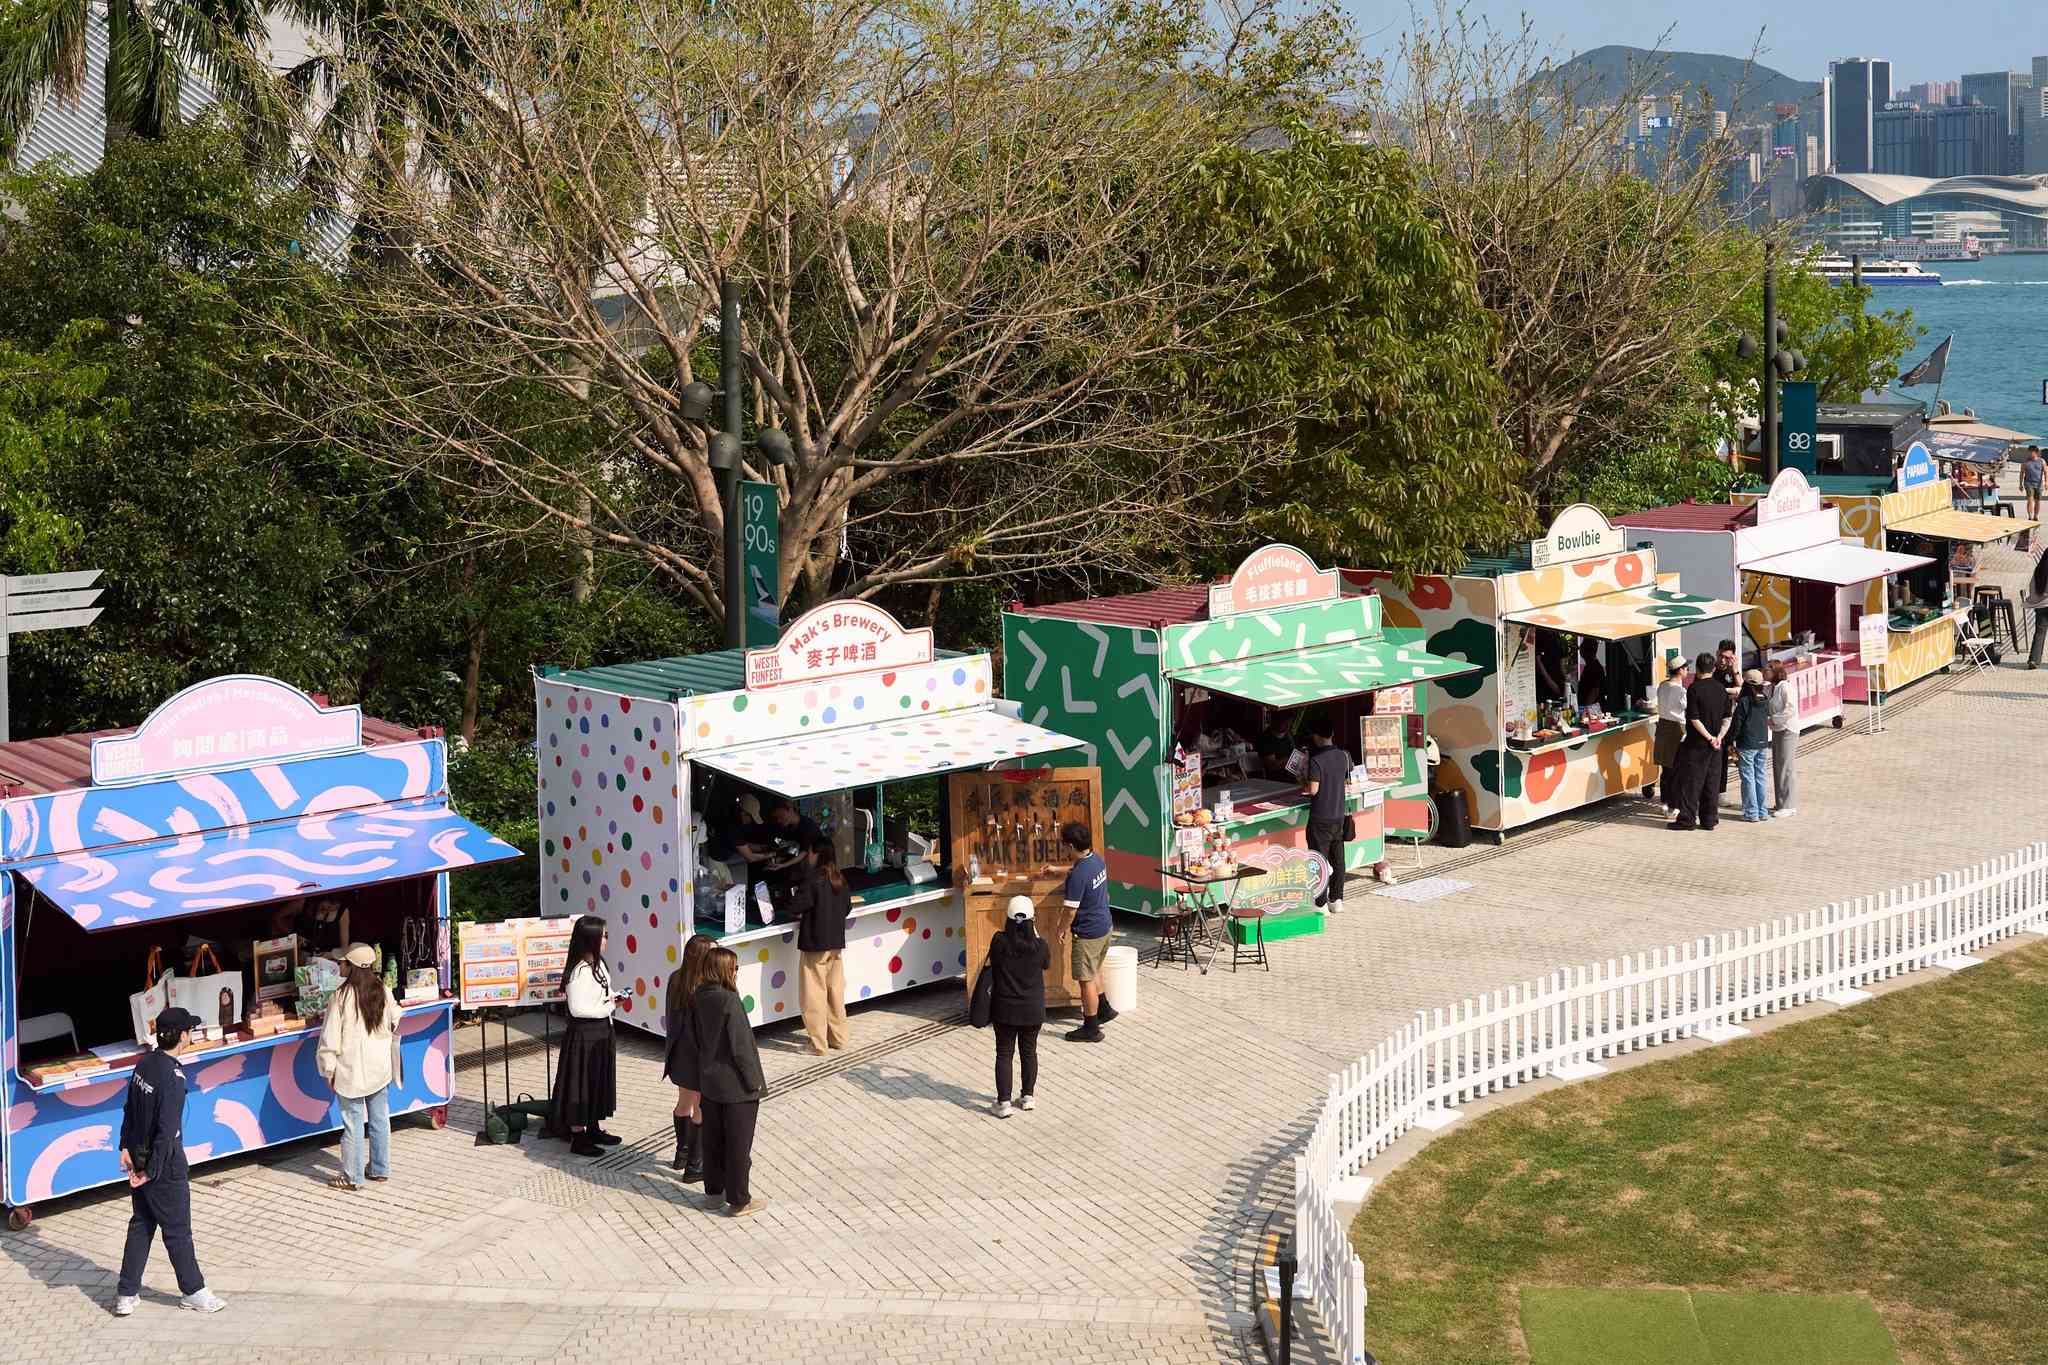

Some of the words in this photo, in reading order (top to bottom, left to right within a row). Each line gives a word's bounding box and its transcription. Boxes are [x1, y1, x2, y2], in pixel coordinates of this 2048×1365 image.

[744, 494, 764, 522] 19
[744, 523, 775, 554] 90s
[1558, 529, 1601, 551] Bowlbie
[789, 619, 830, 656] Mak's
[833, 613, 892, 643] Brewery
[754, 655, 780, 670] WESTK
[806, 641, 877, 670] 麥子啤酒
[751, 668, 783, 685] FUNFEST
